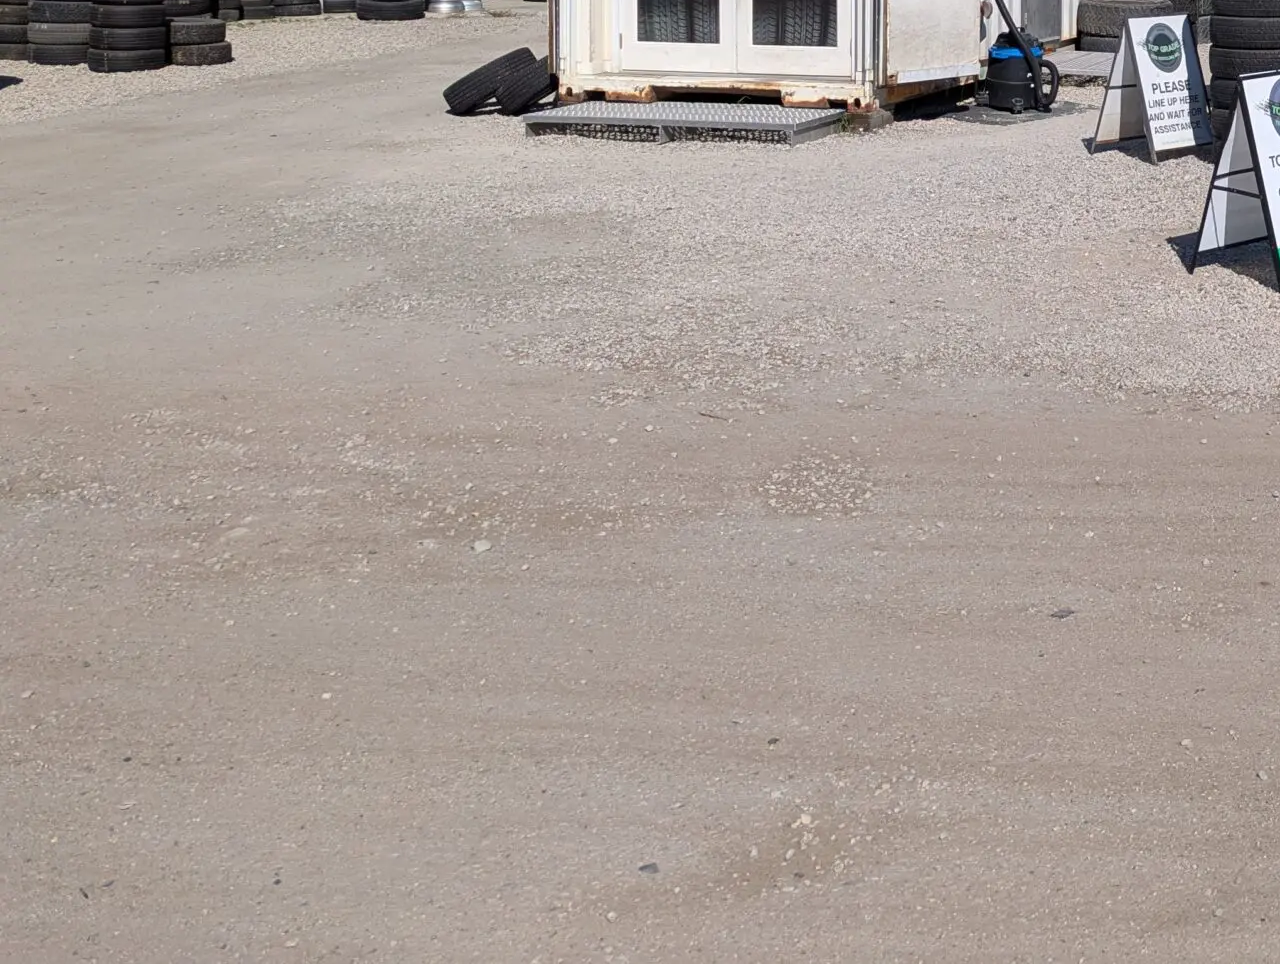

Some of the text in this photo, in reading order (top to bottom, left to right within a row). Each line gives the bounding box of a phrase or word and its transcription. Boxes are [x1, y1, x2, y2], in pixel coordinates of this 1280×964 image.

[1160, 40, 1181, 53] GRADE
[1151, 79, 1192, 95] PLEASE
[1148, 94, 1200, 109] LINE UP HERE
[1148, 107, 1202, 122] AND WAIT FOR
[1154, 120, 1203, 135] ASSISTANCE
